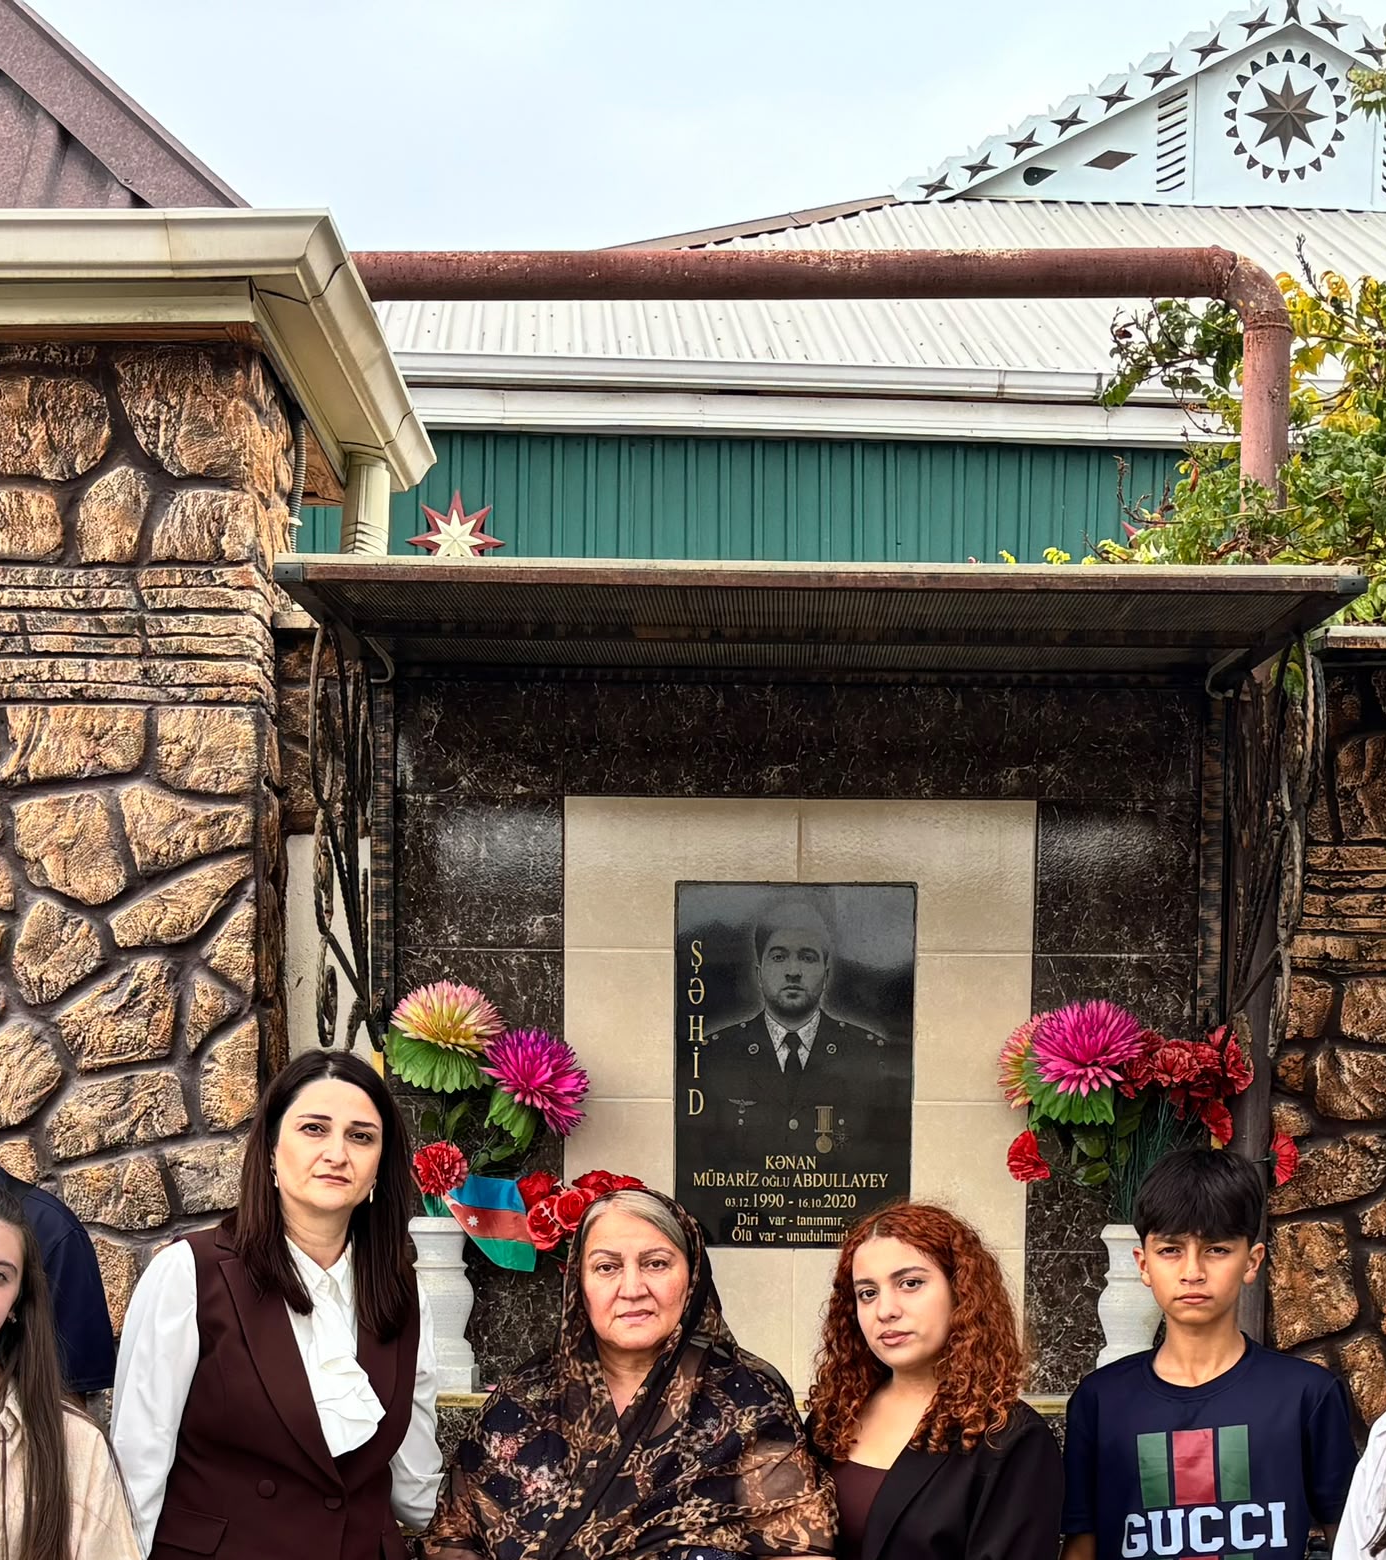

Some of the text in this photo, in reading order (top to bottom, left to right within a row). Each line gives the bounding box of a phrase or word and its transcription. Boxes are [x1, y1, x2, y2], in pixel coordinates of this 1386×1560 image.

[765, 1155, 817, 1171] KƏNAN
[693, 1169, 759, 1187] MÜBARİZ
[762, 1175, 790, 1188] OĞLU
[725, 1193, 784, 1208] 03.12.1990
[798, 1194, 857, 1209] 16.10.2020
[737, 1213, 759, 1226] Diri
[769, 1216, 786, 1226] var
[731, 1226, 753, 1242] Ölü
[758, 1232, 776, 1242] var
[1121, 1501, 1288, 1559] GUCCI
